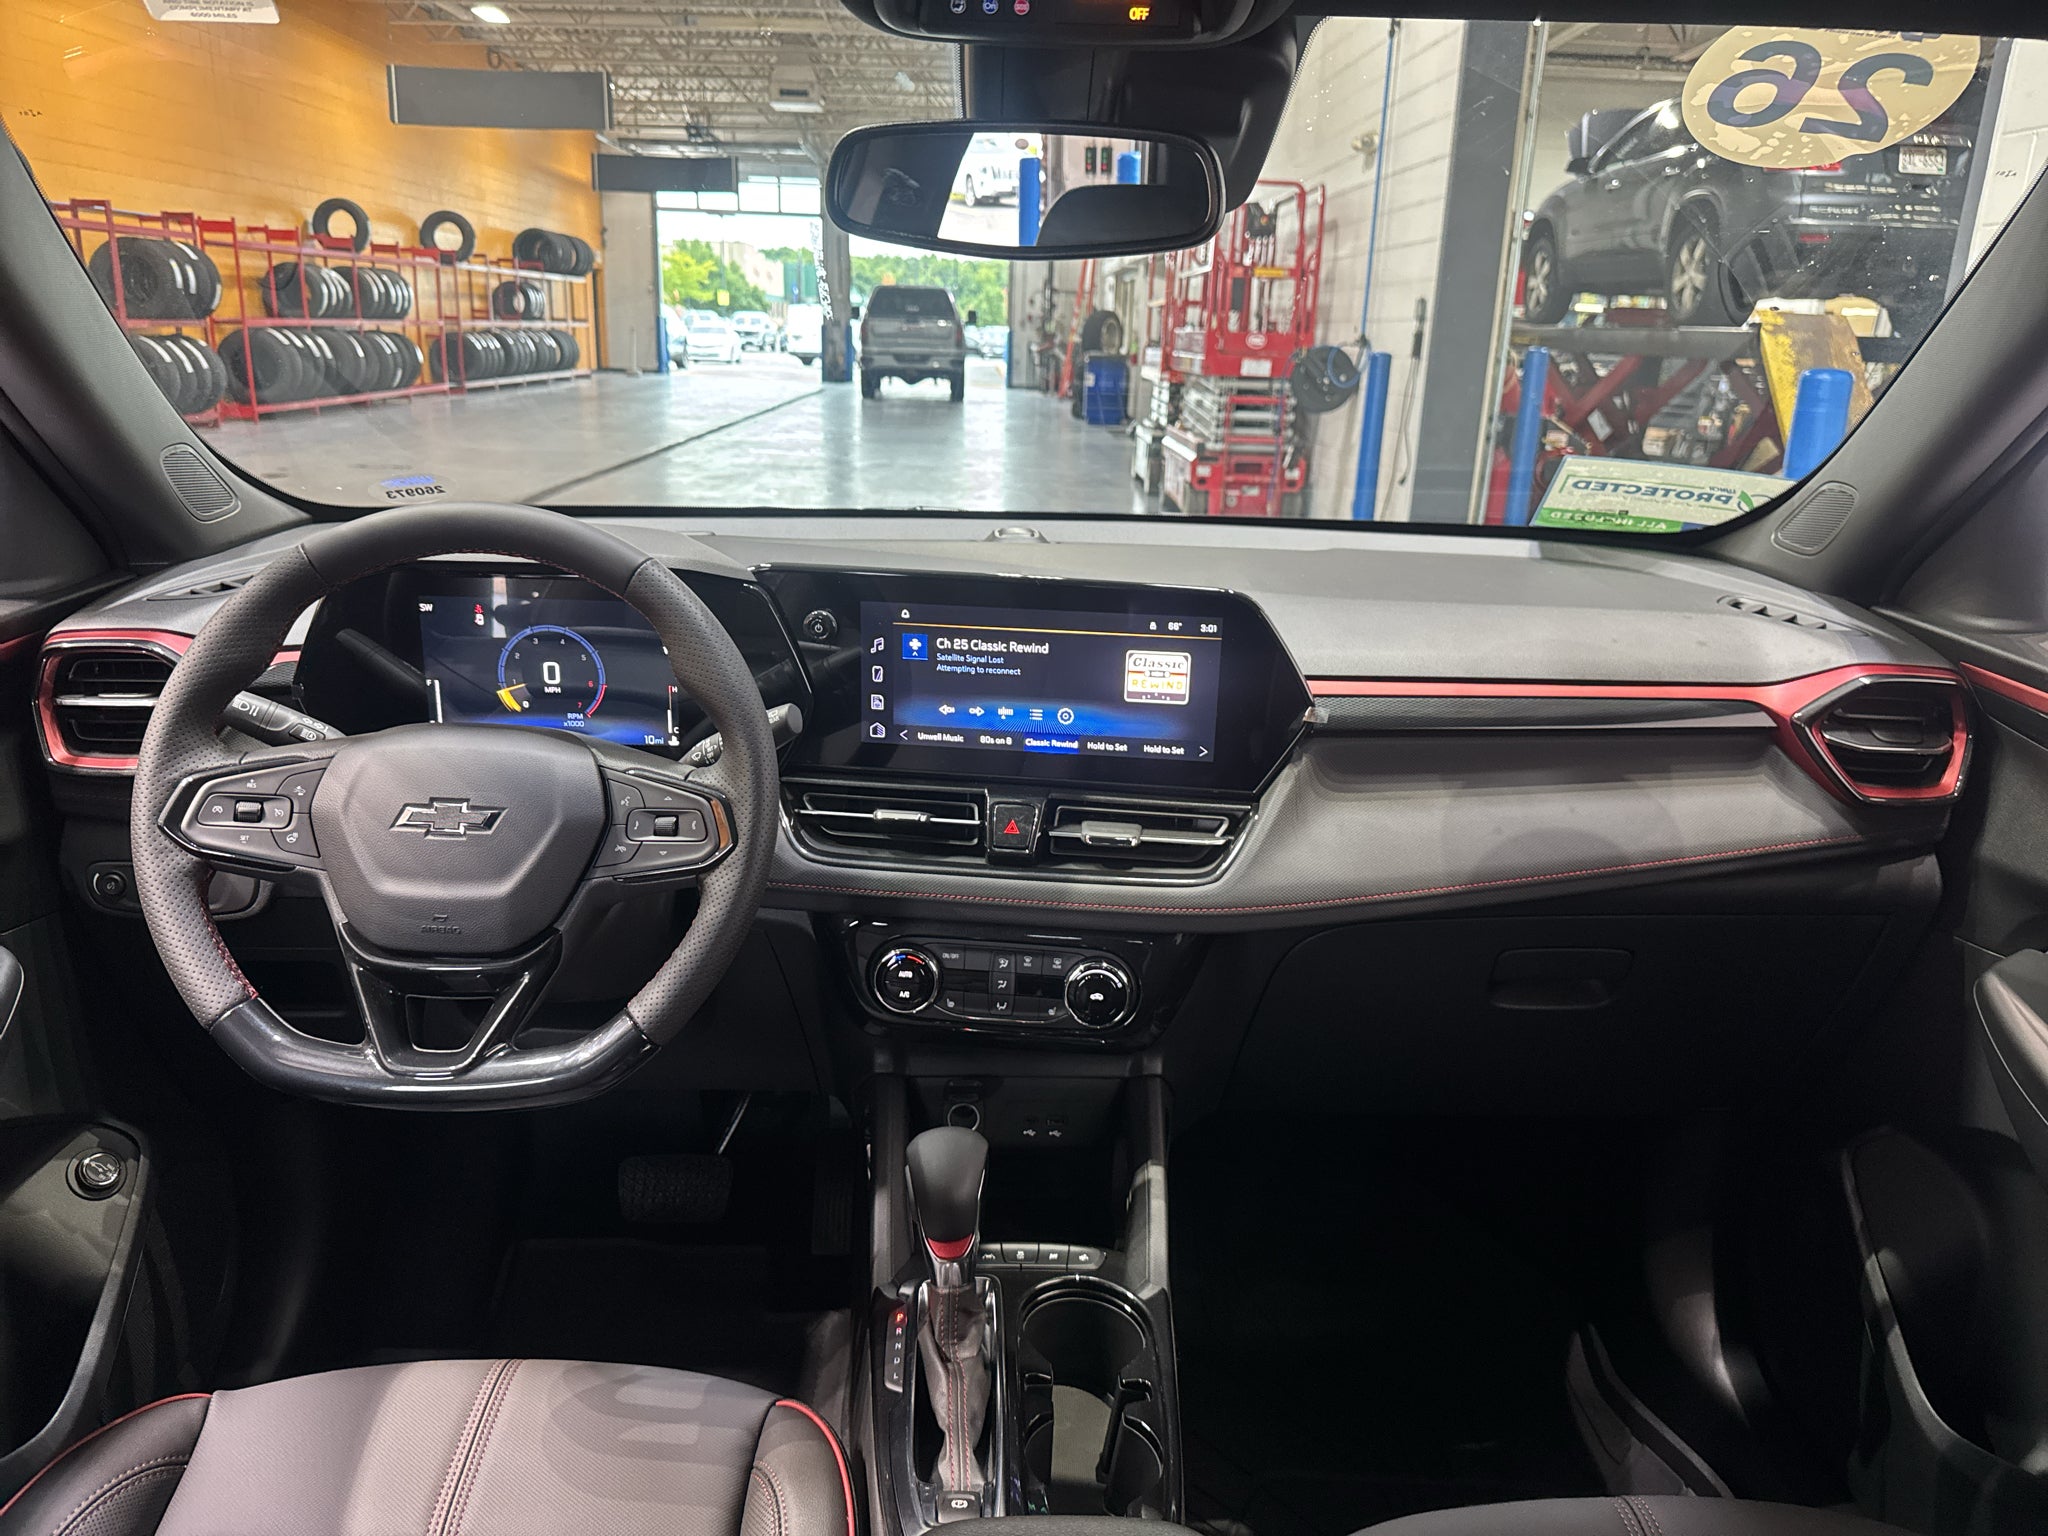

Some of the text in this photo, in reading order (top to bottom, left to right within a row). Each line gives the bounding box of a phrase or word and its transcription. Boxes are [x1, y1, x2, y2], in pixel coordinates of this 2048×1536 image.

[1129, 7, 1150, 21] OFF
[419, 603, 433, 612] SW
[1200, 624, 1218, 633] 3:01
[936, 638, 1049, 655] Ch 25 Classic Rewind
[936, 654, 1004, 666] Satellite Signal Lost
[1133, 657, 1184, 669] Classic
[543, 661, 560, 684] 0
[936, 664, 1021, 676] Attempting to reconnect
[588, 680, 594, 688] 6
[1132, 679, 1183, 690] REWIND
[544, 686, 561, 694] MPH
[567, 712, 584, 720] RPM
[563, 720, 584, 728] x1000
[674, 726, 679, 734] C
[917, 732, 964, 744] Unwell Music
[980, 736, 993, 745] 80s
[996, 738, 1005, 746] on
[1025, 738, 1078, 750] Classic Rewind
[1087, 742, 1128, 752] Hold to Set
[1144, 744, 1184, 756] Hold to Set
[421, 925, 462, 934] AIRBAG
[942, 952, 960, 960] ON/OFF
[898, 971, 913, 979] AUTO
[899, 990, 910, 998] A/C
[896, 1313, 903, 1322] P
[896, 1327, 902, 1335] R
[895, 1342, 902, 1350] N
